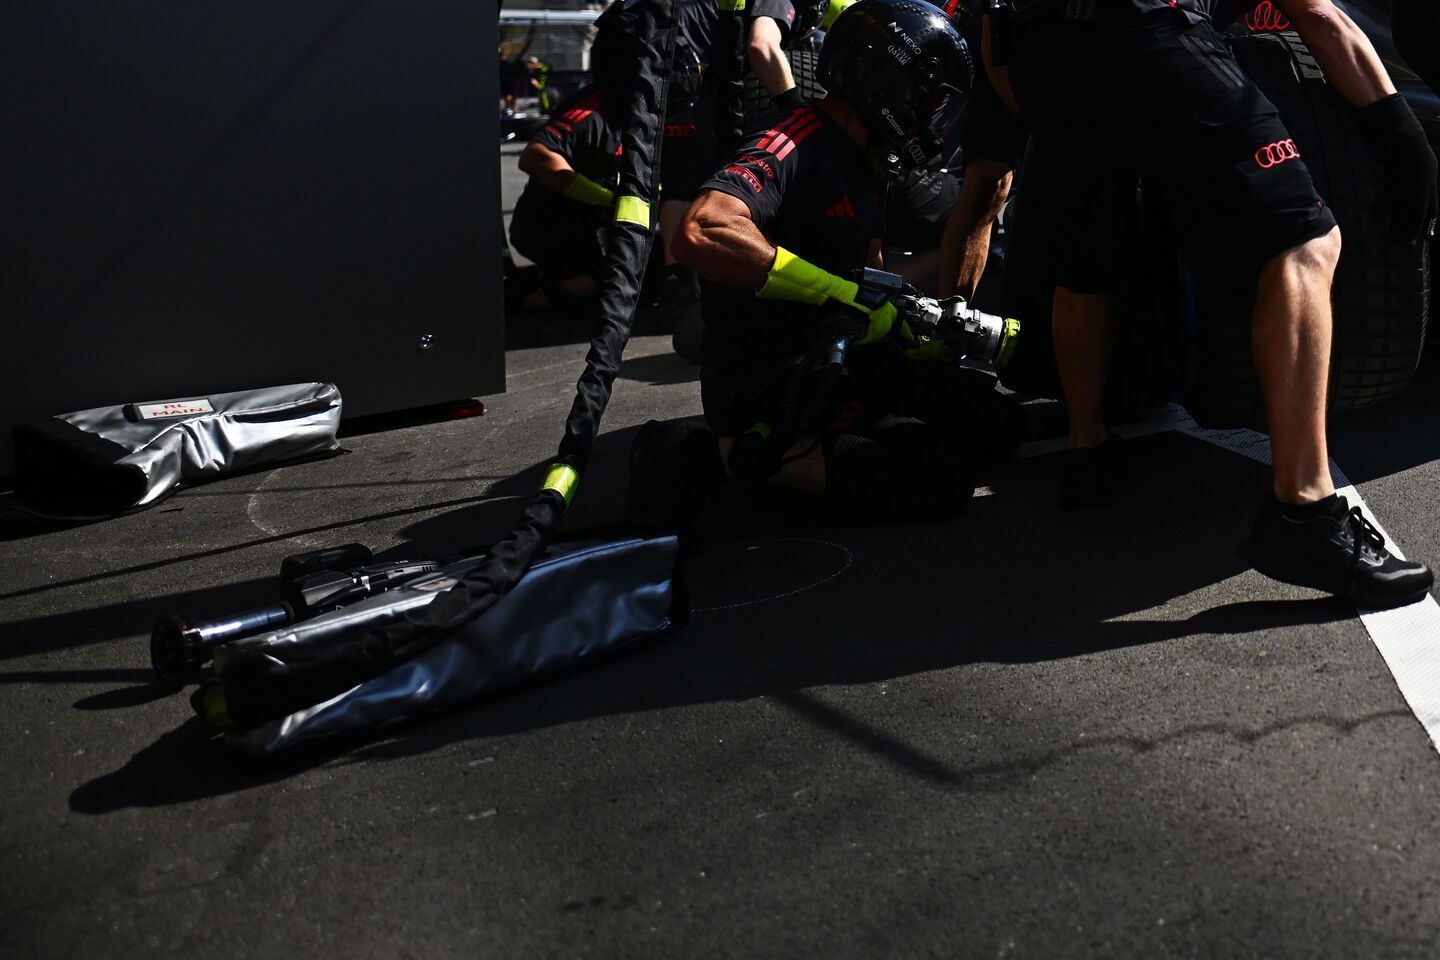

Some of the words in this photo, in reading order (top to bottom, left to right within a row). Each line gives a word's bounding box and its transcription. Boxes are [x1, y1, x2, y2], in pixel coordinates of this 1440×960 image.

[887, 44, 908, 67] QATAR
[900, 32, 922, 56] NEXO
[152, 407, 204, 417] MAIN
